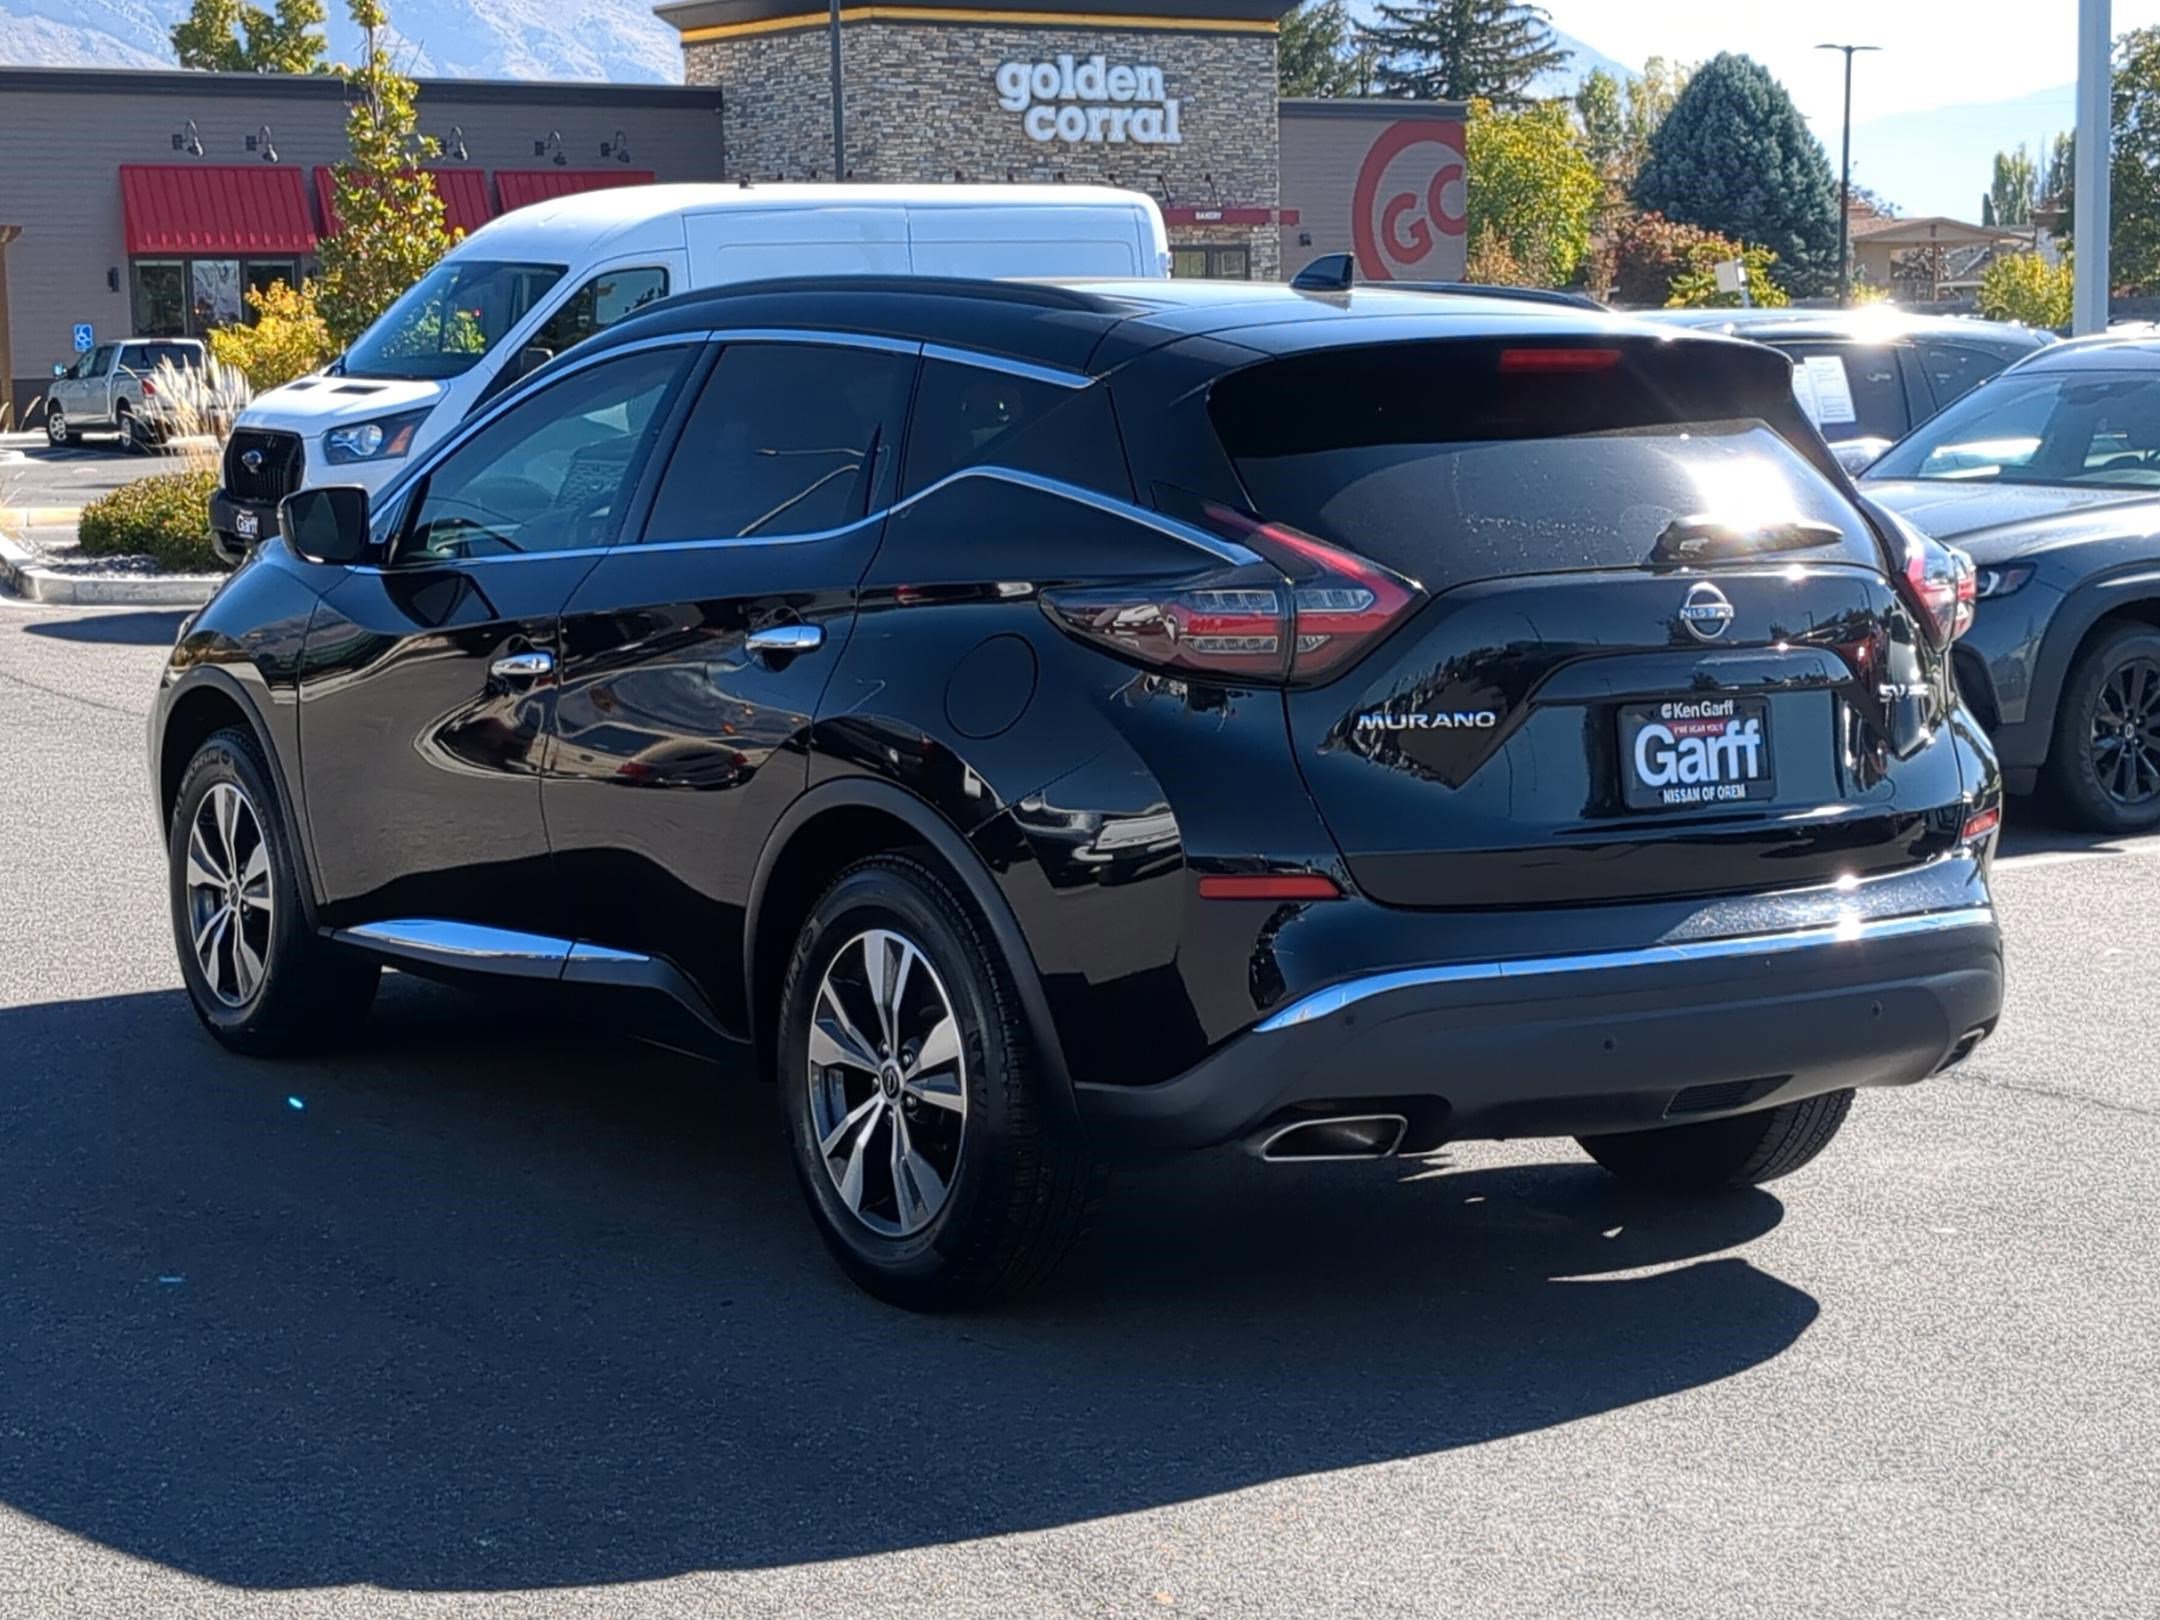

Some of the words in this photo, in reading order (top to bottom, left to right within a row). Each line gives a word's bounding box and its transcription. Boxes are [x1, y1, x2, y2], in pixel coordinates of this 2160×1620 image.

[995, 54, 1166, 111] golden
[1024, 99, 1182, 143] corral
[1356, 711, 1496, 730] MURANO
[1673, 702, 1700, 718] Ken
[1701, 700, 1734, 717] Garff
[1635, 718, 1761, 787] Garff
[1663, 787, 1700, 803] NISSAN
[1702, 785, 1716, 801] OF
[1717, 784, 1746, 800] OREM
